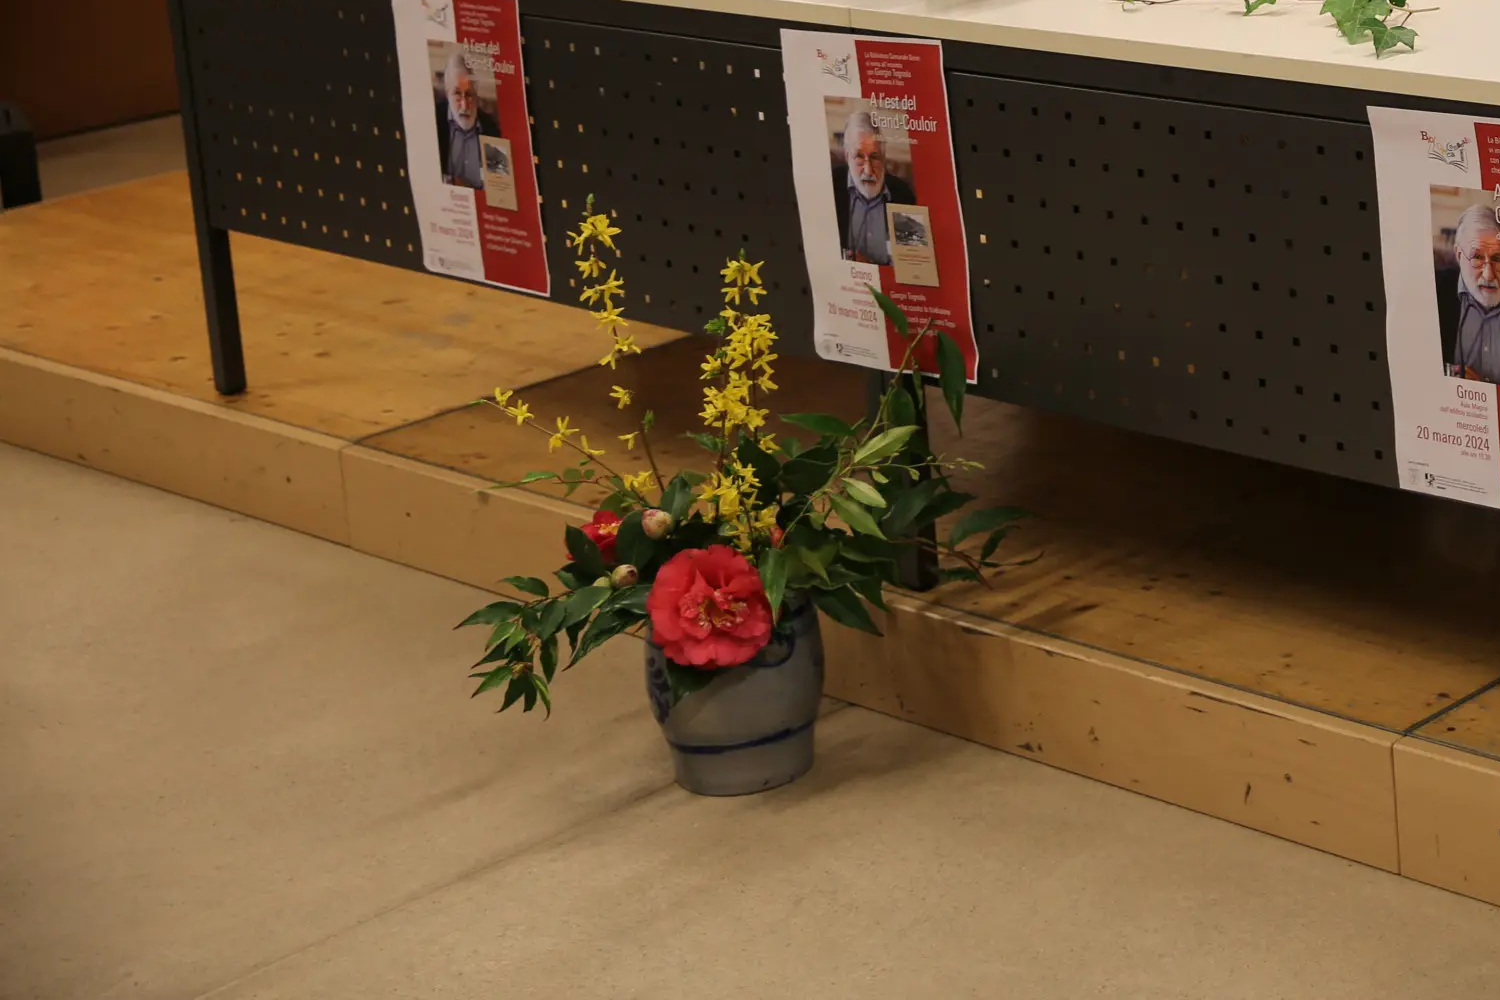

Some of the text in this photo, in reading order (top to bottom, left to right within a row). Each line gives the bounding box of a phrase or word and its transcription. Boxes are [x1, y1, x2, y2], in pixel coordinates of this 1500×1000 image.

[870, 91, 916, 111] A l'est del
[871, 111, 938, 132] Grand-Couloir
[1487, 136, 1494, 144] La
[1456, 384, 1487, 402] Grono
[1456, 420, 1489, 434] mercoledì
[1416, 425, 1490, 451] 20 marzo 2024
